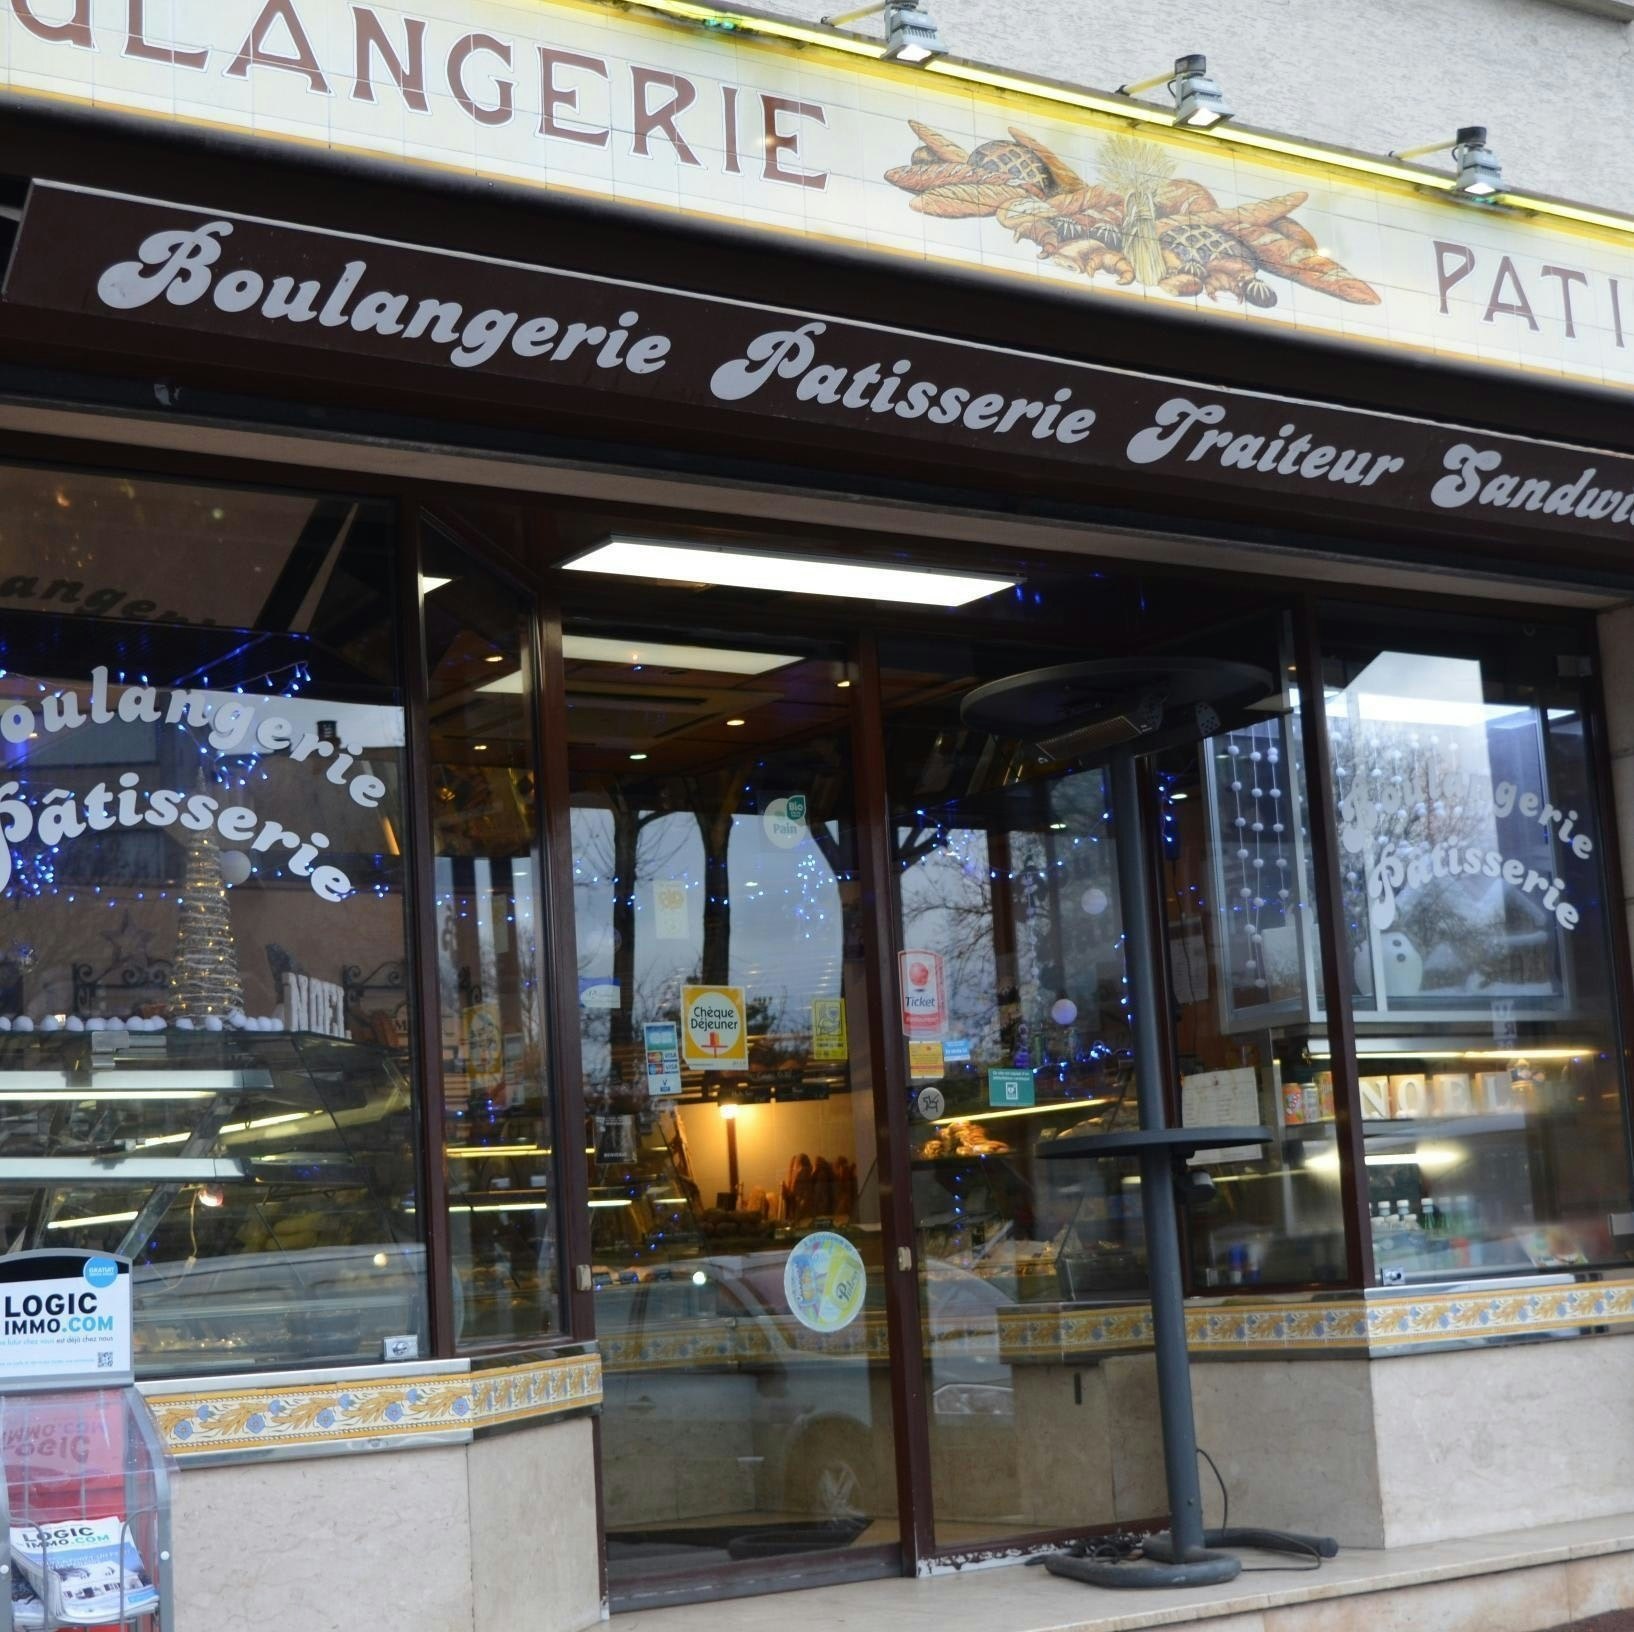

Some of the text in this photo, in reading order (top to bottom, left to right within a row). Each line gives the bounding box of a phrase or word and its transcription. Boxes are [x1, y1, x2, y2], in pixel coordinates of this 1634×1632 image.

[1432, 239, 1626, 349] PATI
[97, 220, 1634, 526] Boulangerie Patisserie Traiteur Sandwi
[788, 801, 803, 811] Bio
[773, 822, 798, 835] Pain
[905, 996, 936, 1008] Ticket
[693, 1006, 734, 1020] Chèque
[690, 1018, 738, 1031] Déjeuner
[5, 1292, 97, 1317] LOGIC
[5, 1316, 113, 1335] IMMO.COM
[22, 1526, 94, 1543] LOGIC
[26, 1534, 110, 1549] IMMO.COM
